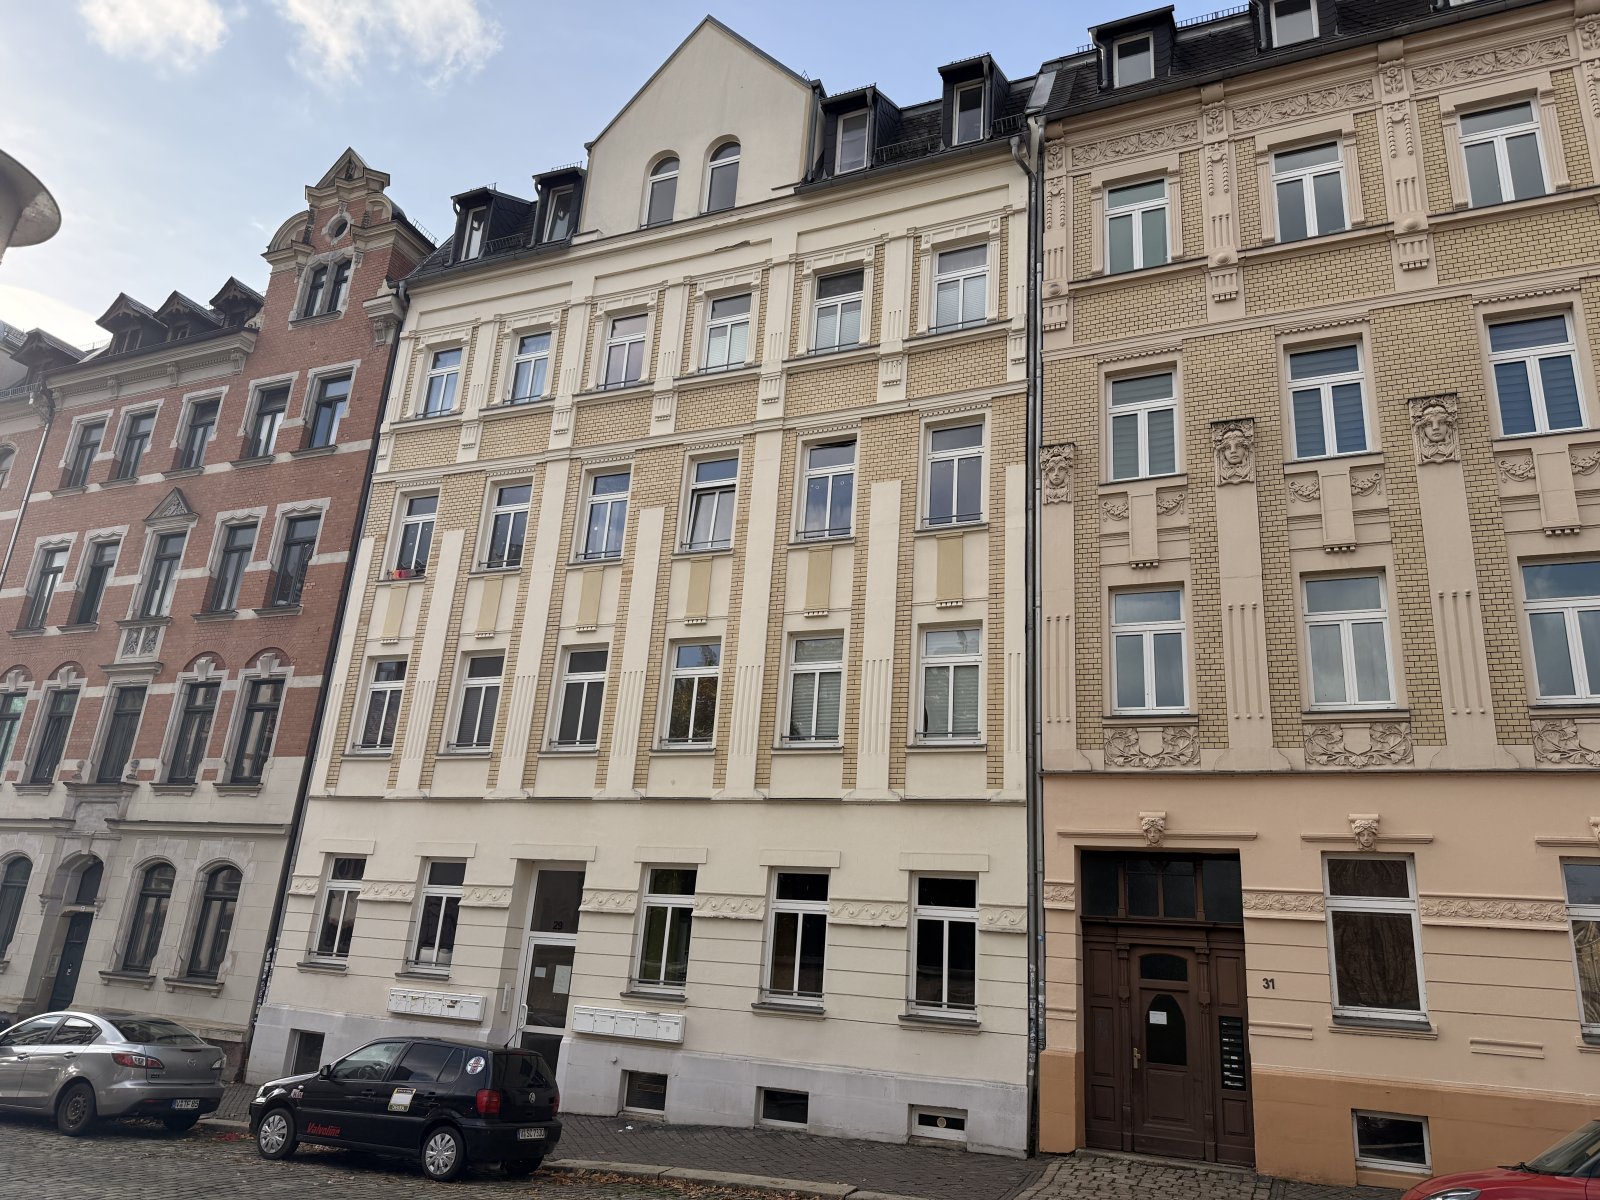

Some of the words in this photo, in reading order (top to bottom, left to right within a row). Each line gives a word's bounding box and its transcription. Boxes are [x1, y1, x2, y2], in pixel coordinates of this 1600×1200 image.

[553, 920, 563, 930] 29
[1262, 977, 1275, 990] 31
[307, 1121, 341, 1137] Valvoline
